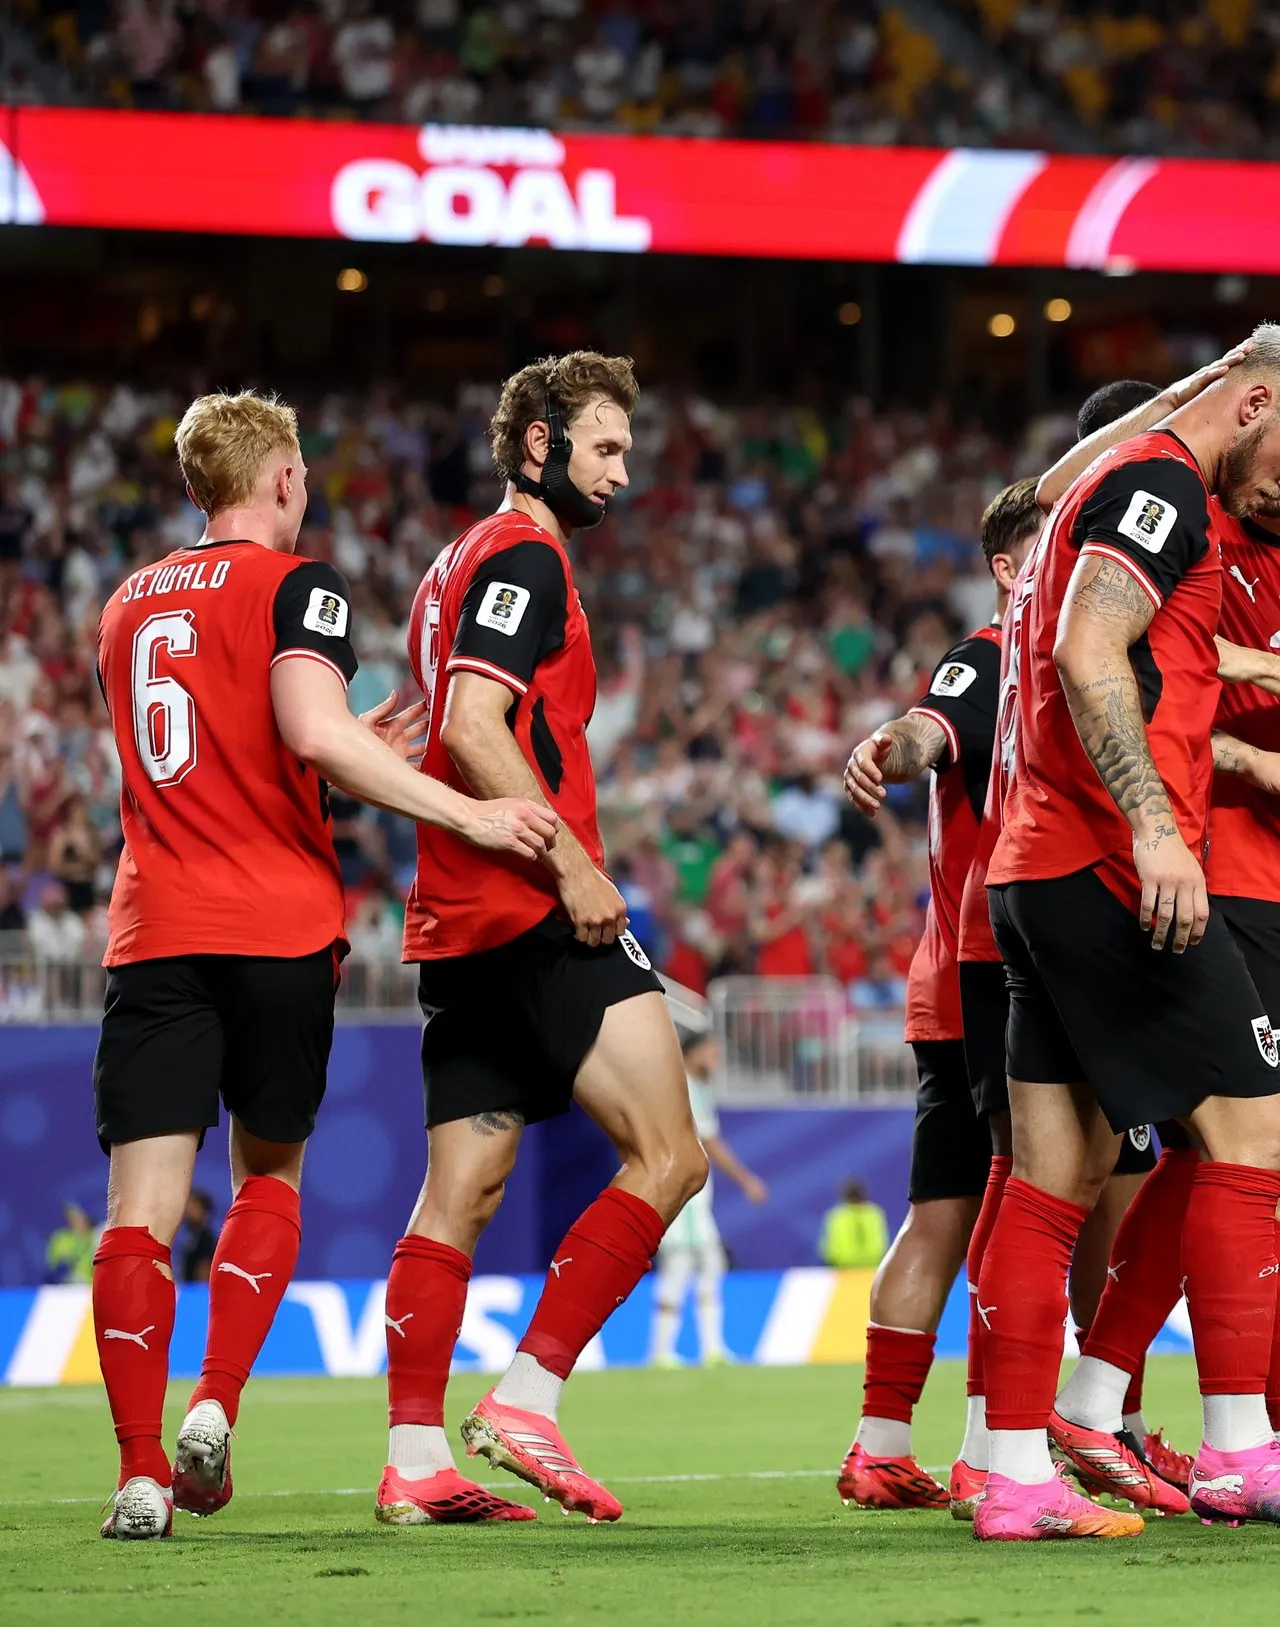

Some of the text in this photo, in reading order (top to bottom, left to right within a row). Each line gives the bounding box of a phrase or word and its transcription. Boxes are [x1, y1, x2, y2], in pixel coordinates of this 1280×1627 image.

[331, 160, 652, 253] GOAL
[122, 560, 231, 603] SEIWALD
[131, 608, 198, 789] 6
